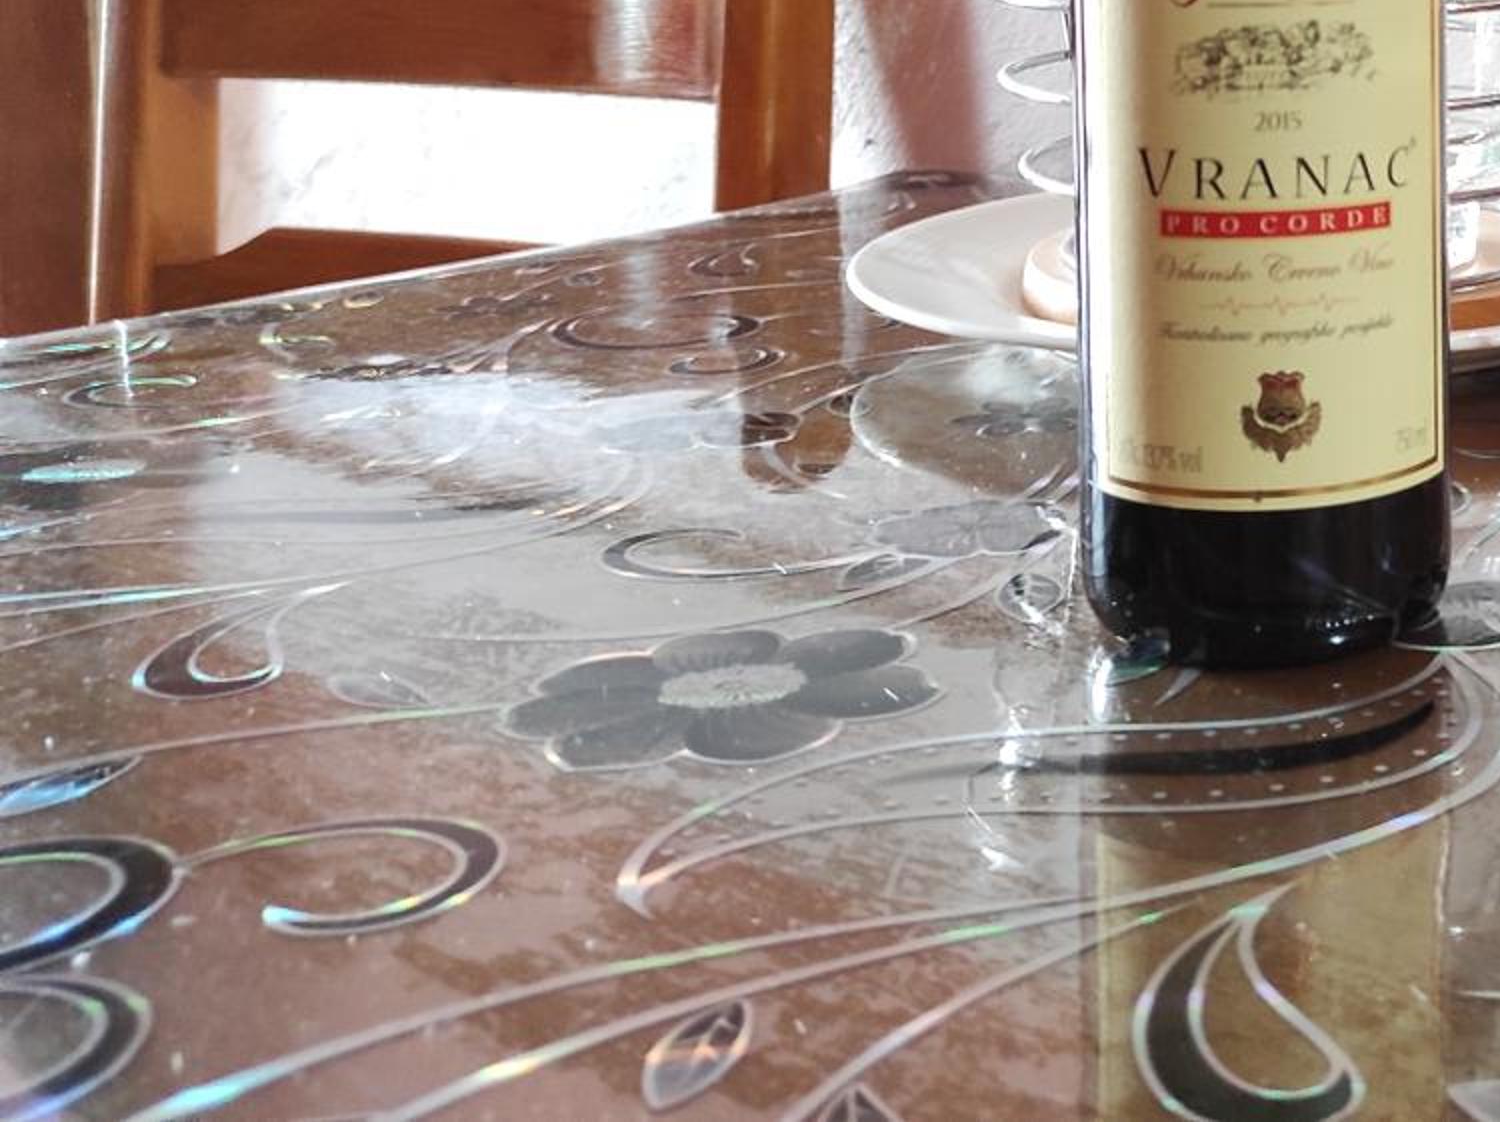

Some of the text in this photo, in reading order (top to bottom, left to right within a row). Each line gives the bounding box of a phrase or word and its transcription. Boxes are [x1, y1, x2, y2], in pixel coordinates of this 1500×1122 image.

[1253, 109, 1305, 132] 2015
[1137, 145, 1411, 201] VRANAC
[1166, 206, 1388, 235] PRO CORDE
